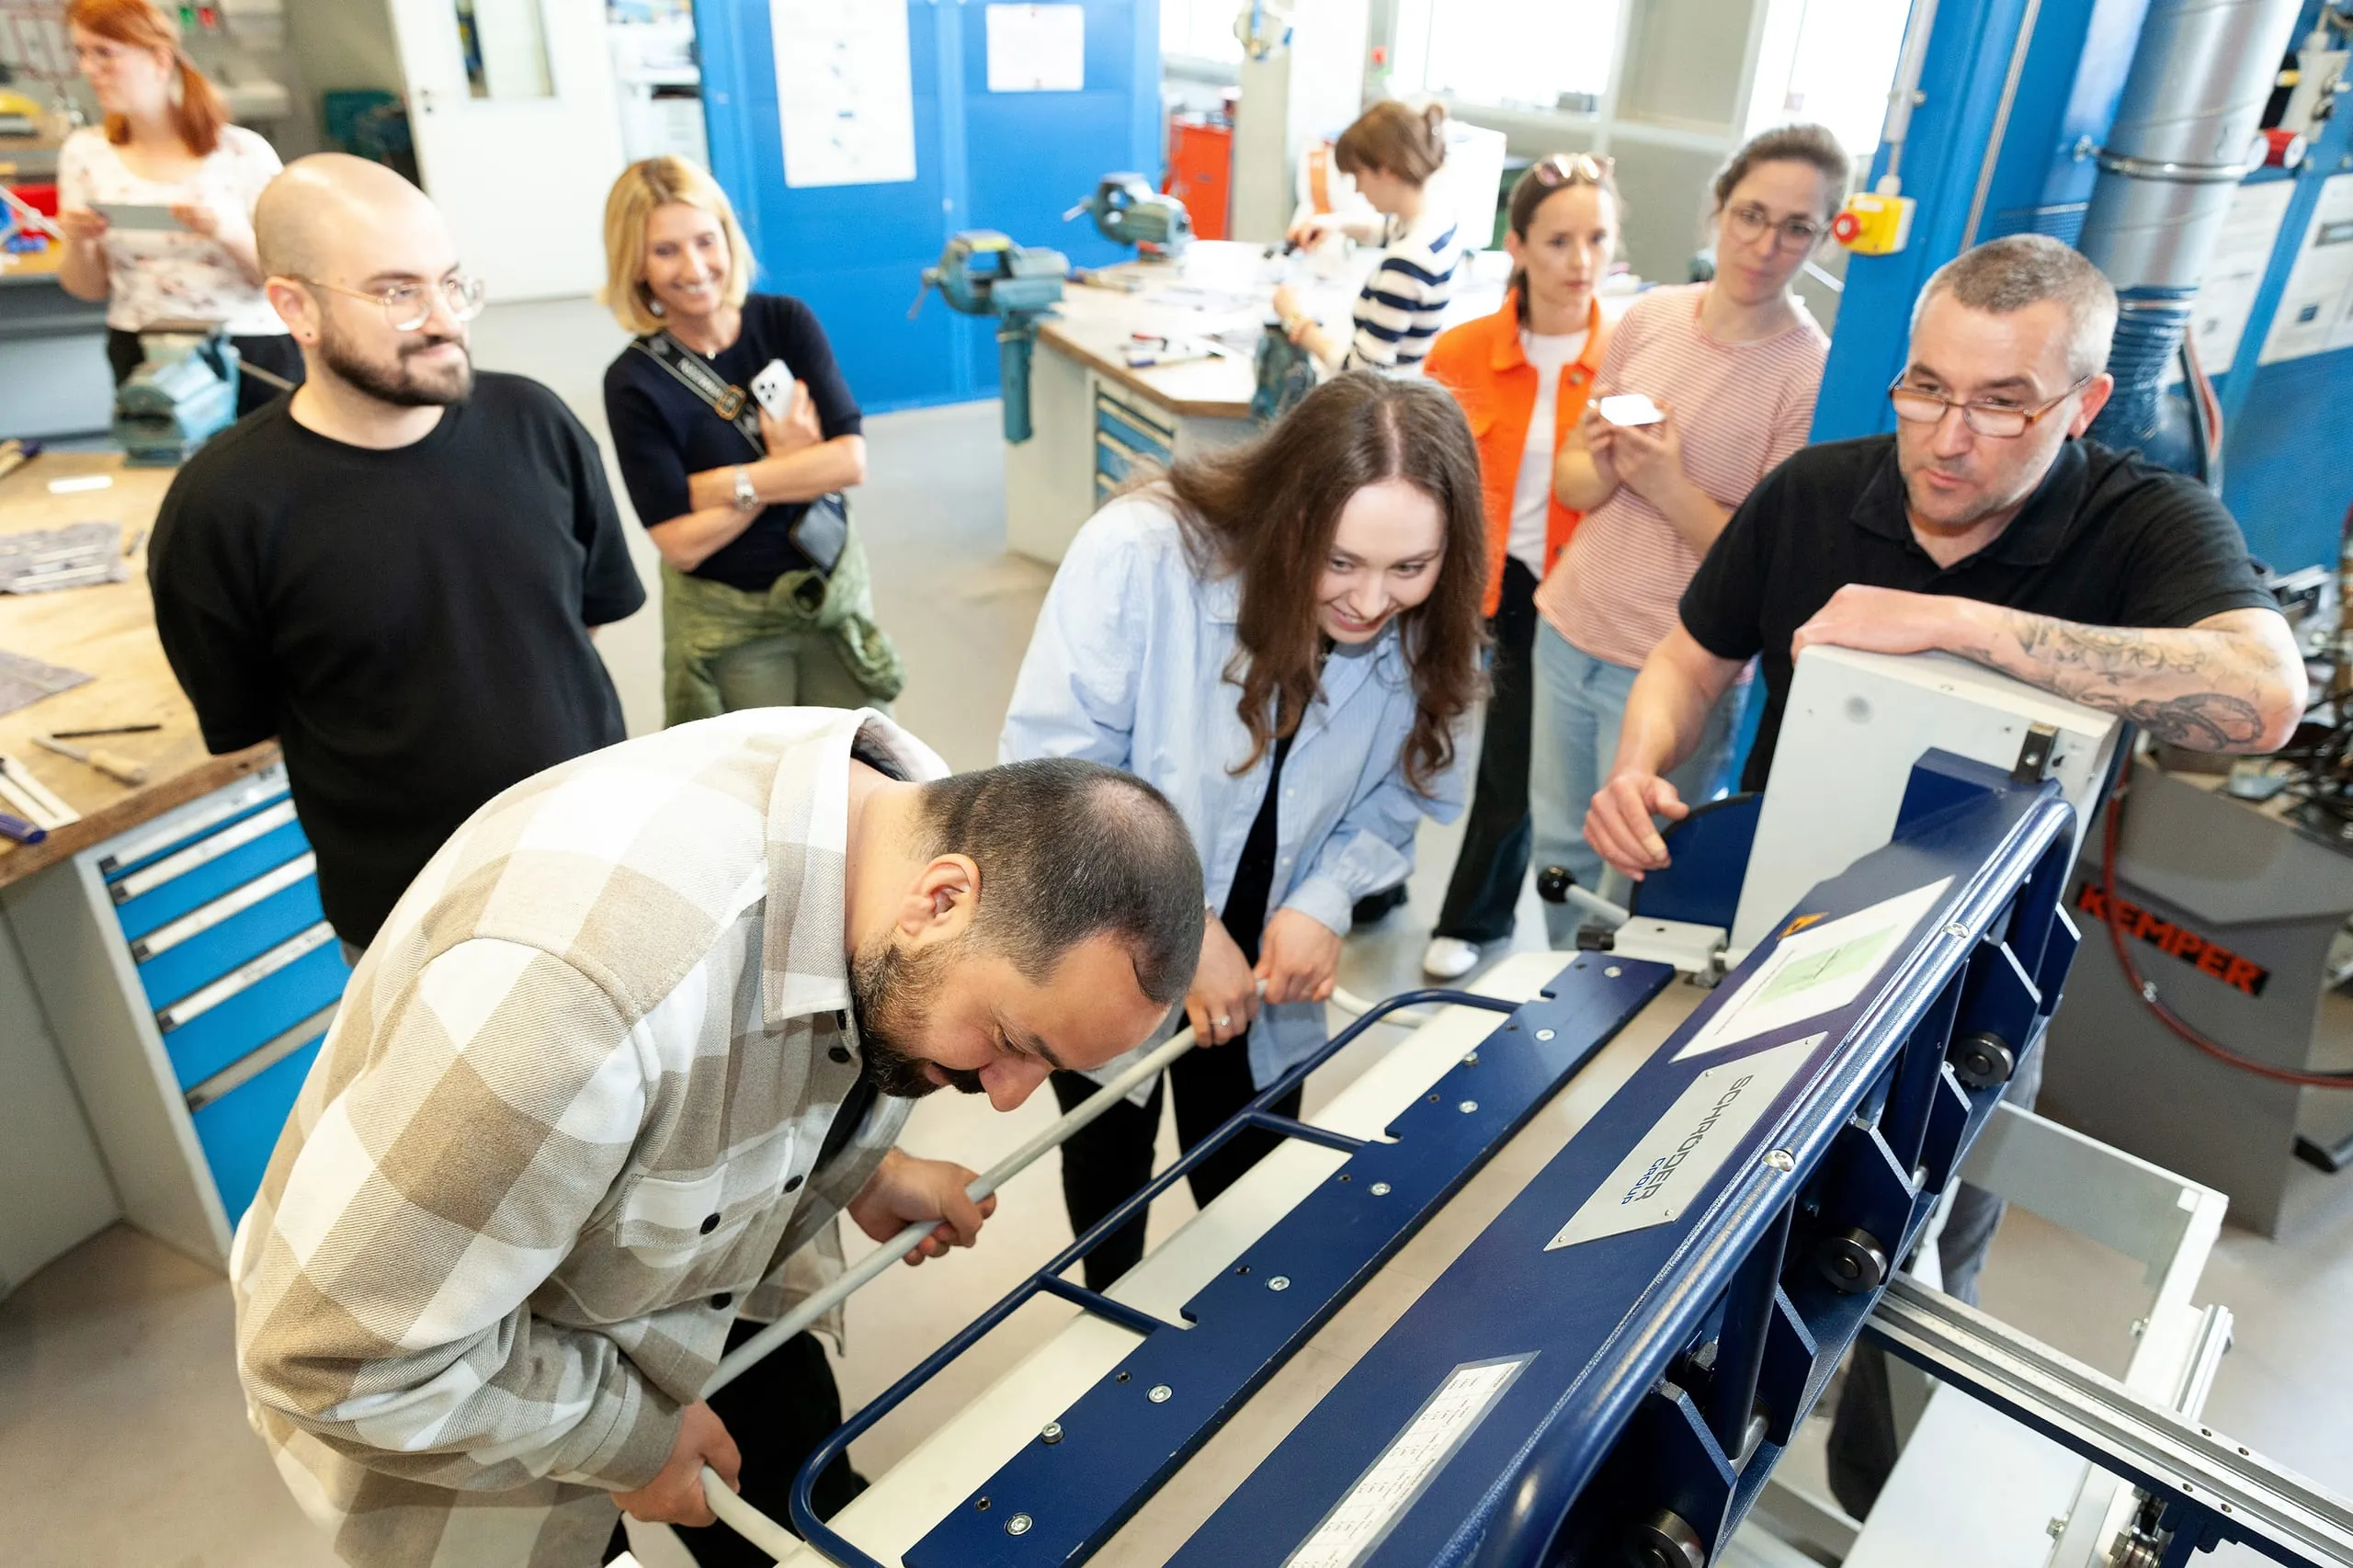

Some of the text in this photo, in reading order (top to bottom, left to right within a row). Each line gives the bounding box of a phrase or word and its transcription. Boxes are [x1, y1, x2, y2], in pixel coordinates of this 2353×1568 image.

[2076, 883, 2264, 994] KEMPER
[1621, 1157, 1666, 1205] GROUP
[1633, 1074, 1754, 1202] SCHRÖDER
